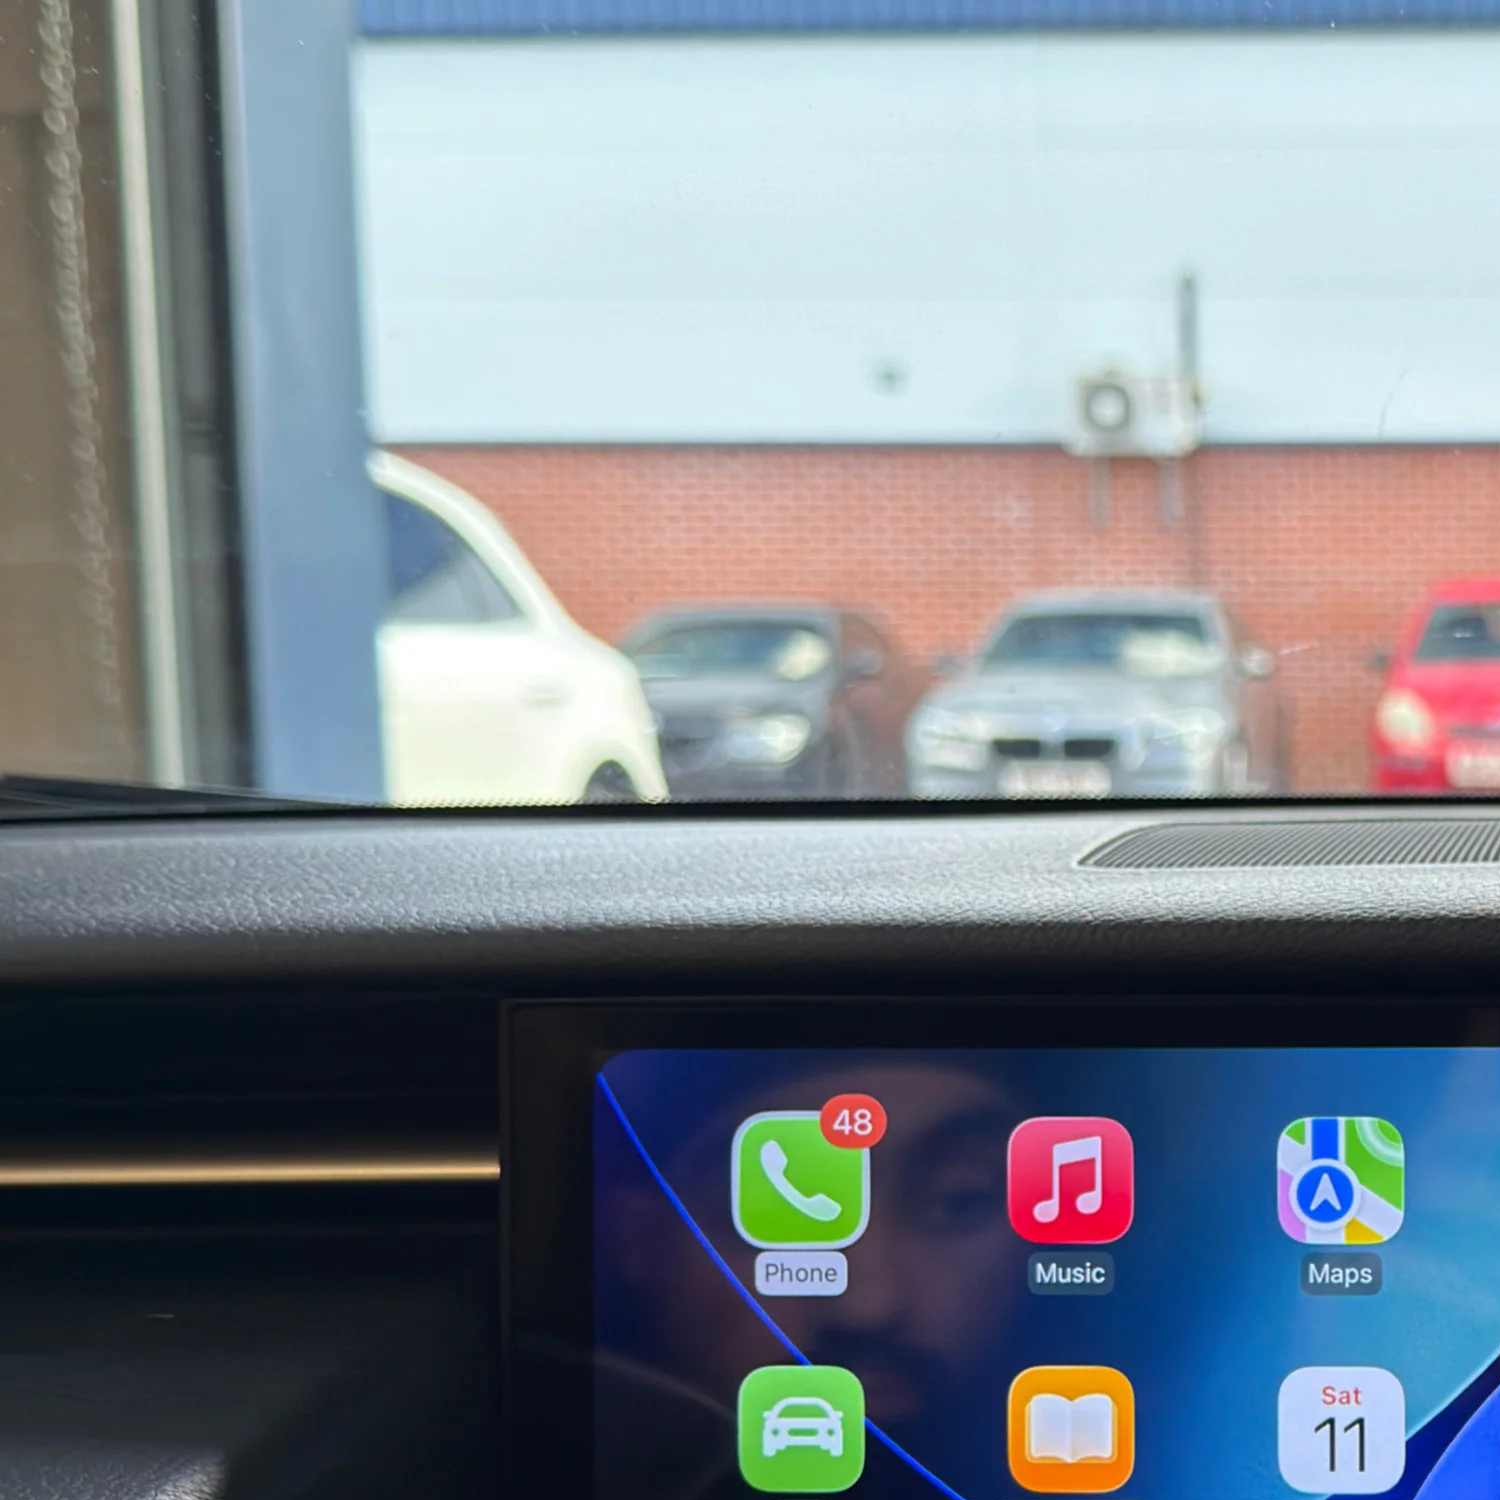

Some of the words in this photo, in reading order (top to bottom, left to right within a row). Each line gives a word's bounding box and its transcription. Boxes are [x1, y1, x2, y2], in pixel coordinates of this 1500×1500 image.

[832, 1109, 873, 1137] 48
[764, 1262, 838, 1285] Phone
[1035, 1261, 1106, 1285] Music
[1308, 1262, 1373, 1290] Maps
[1321, 1386, 1362, 1406] Sat
[1314, 1416, 1366, 1473] 11
